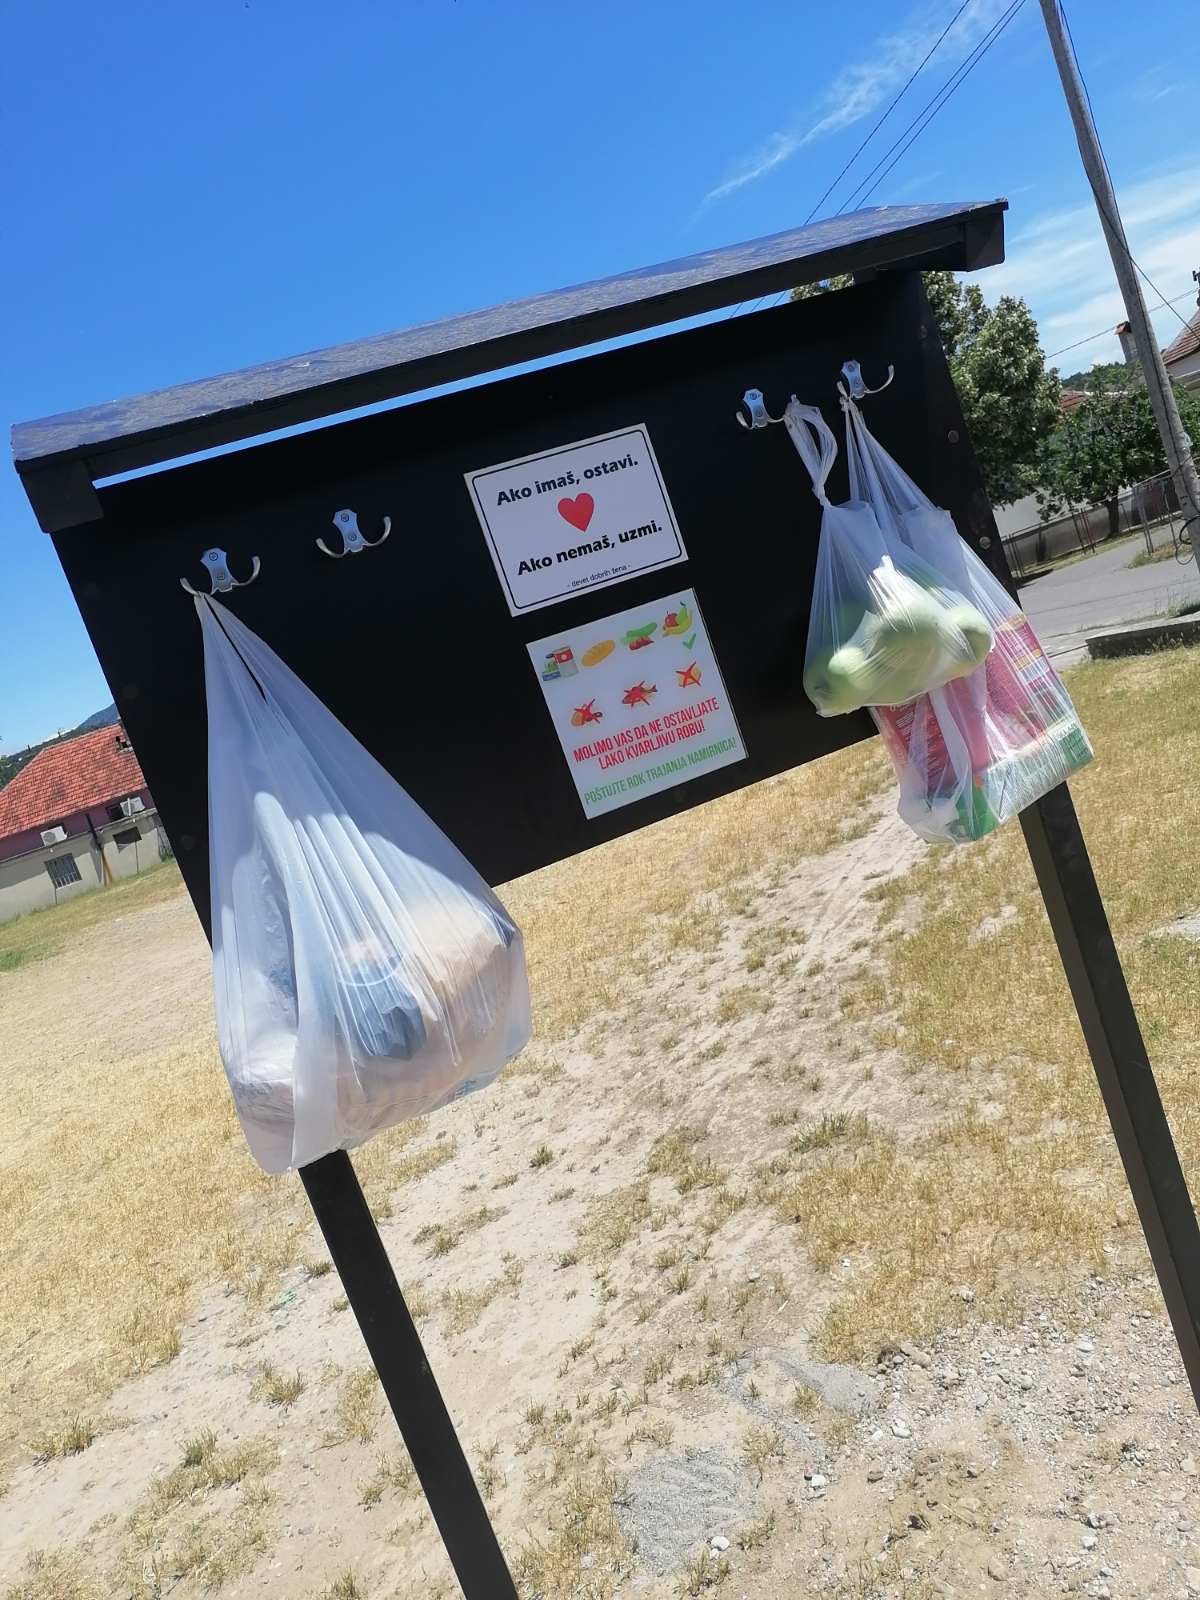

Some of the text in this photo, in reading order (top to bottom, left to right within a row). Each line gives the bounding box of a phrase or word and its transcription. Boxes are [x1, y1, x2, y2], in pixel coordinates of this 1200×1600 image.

[497, 455, 638, 505] Ako imaš, ostavi.
[518, 520, 662, 575] Ako nemaš, uzmi.
[590, 569, 611, 581] dobrih
[574, 697, 719, 763] MOLIMO VAS DA NE OSTAVLJATE
[598, 721, 705, 770] LAKO KVARLJIVU ROBU!
[584, 737, 736, 804] POŠTUJTE ROK TRAJANJA NAMIRNICA!
